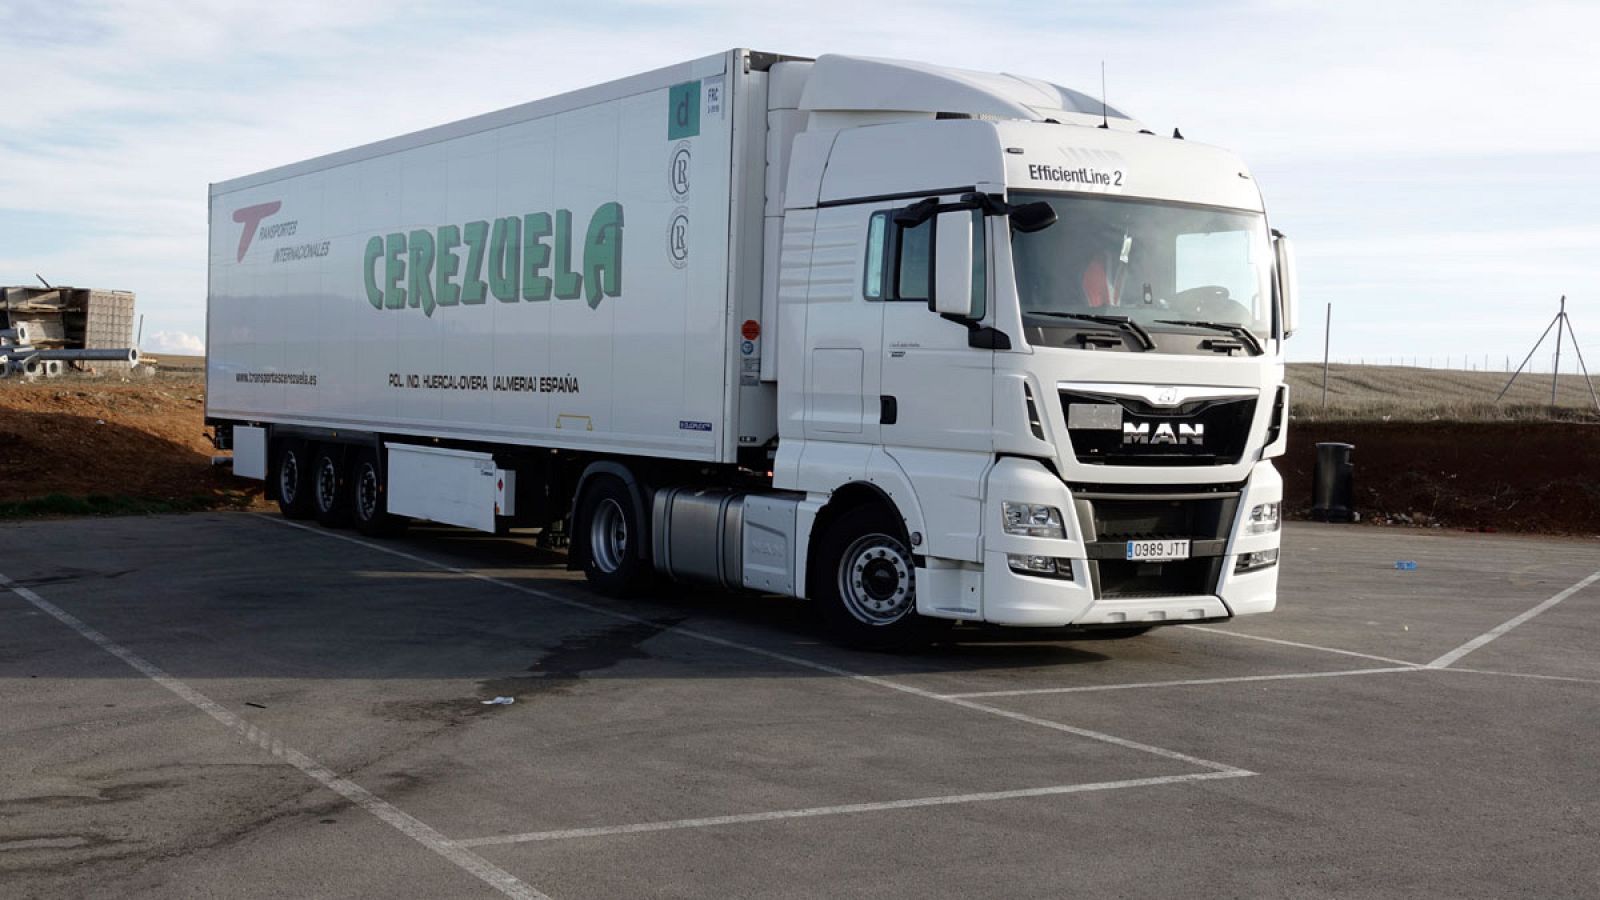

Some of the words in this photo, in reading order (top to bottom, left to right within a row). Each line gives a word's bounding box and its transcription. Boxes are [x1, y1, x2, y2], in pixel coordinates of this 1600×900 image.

[1028, 164, 1110, 186] EfficientLine
[1113, 171, 1122, 186] 2
[273, 241, 330, 263] INTERNACIONALES
[363, 201, 624, 318] CEREZUELA
[539, 373, 579, 393] ESPAÑA
[1123, 422, 1204, 444] MAN
[1135, 542, 1163, 556] 0989
[1167, 542, 1187, 556] JTT
